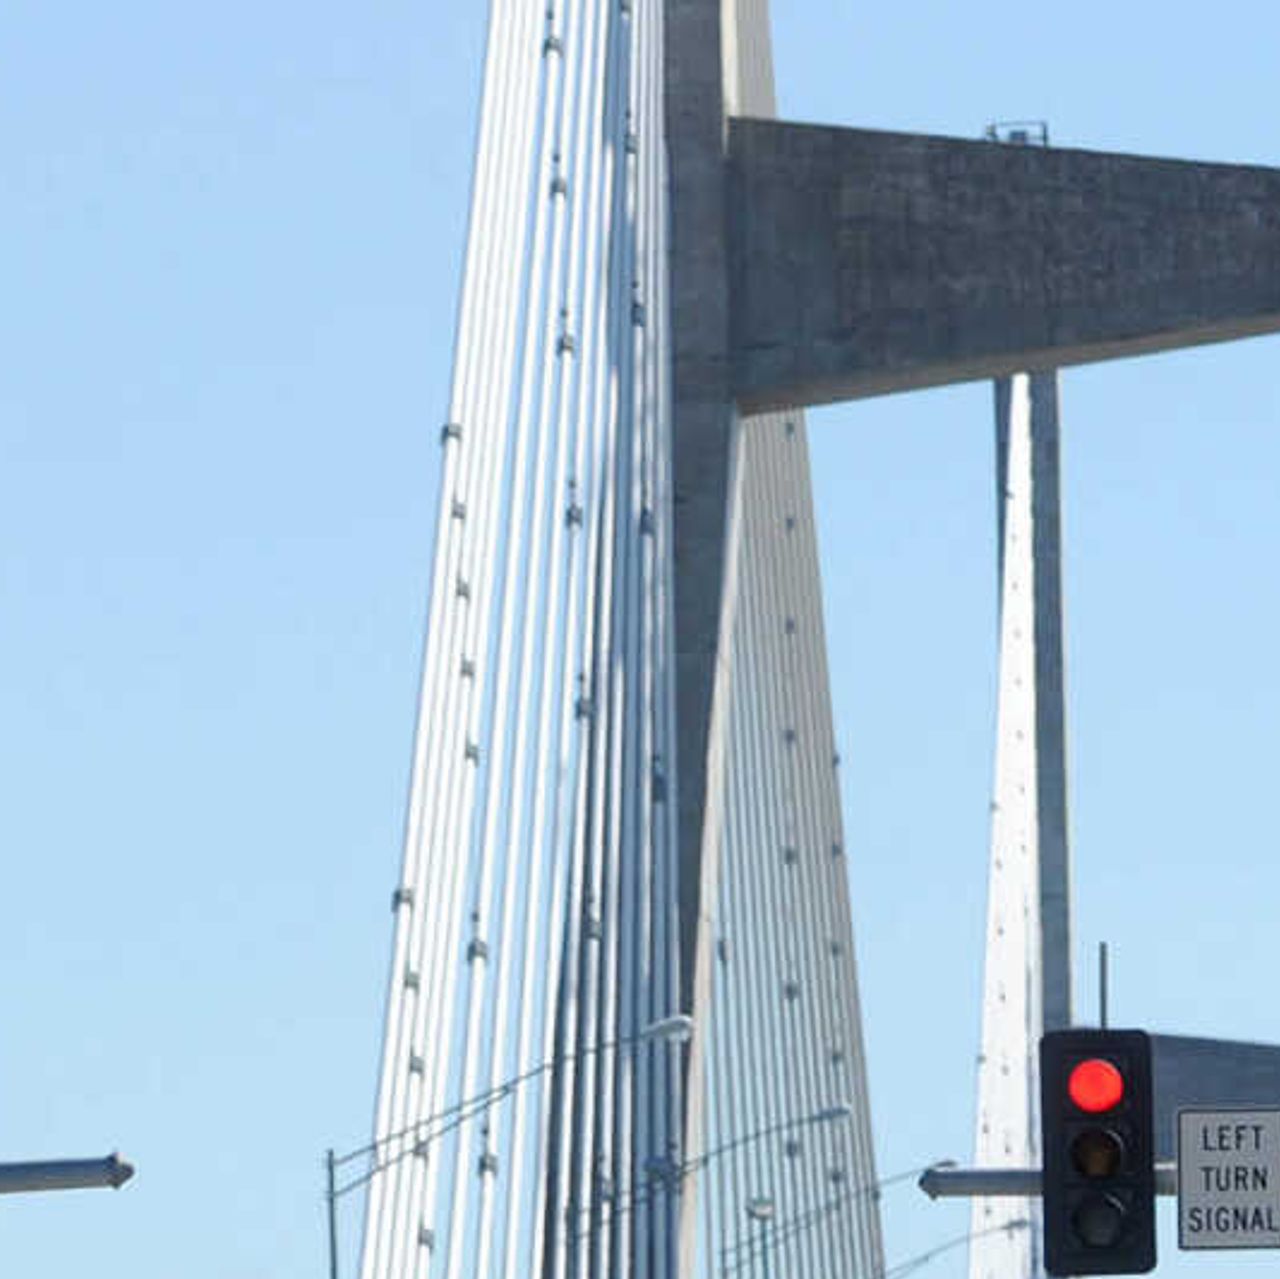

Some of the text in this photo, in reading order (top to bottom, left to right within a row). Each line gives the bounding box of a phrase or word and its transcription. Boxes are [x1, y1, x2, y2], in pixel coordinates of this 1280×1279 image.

[1201, 1125, 1265, 1151] LEFT
[1201, 1166, 1269, 1191] TURN
[1188, 1207, 1280, 1232] SIGNAL
